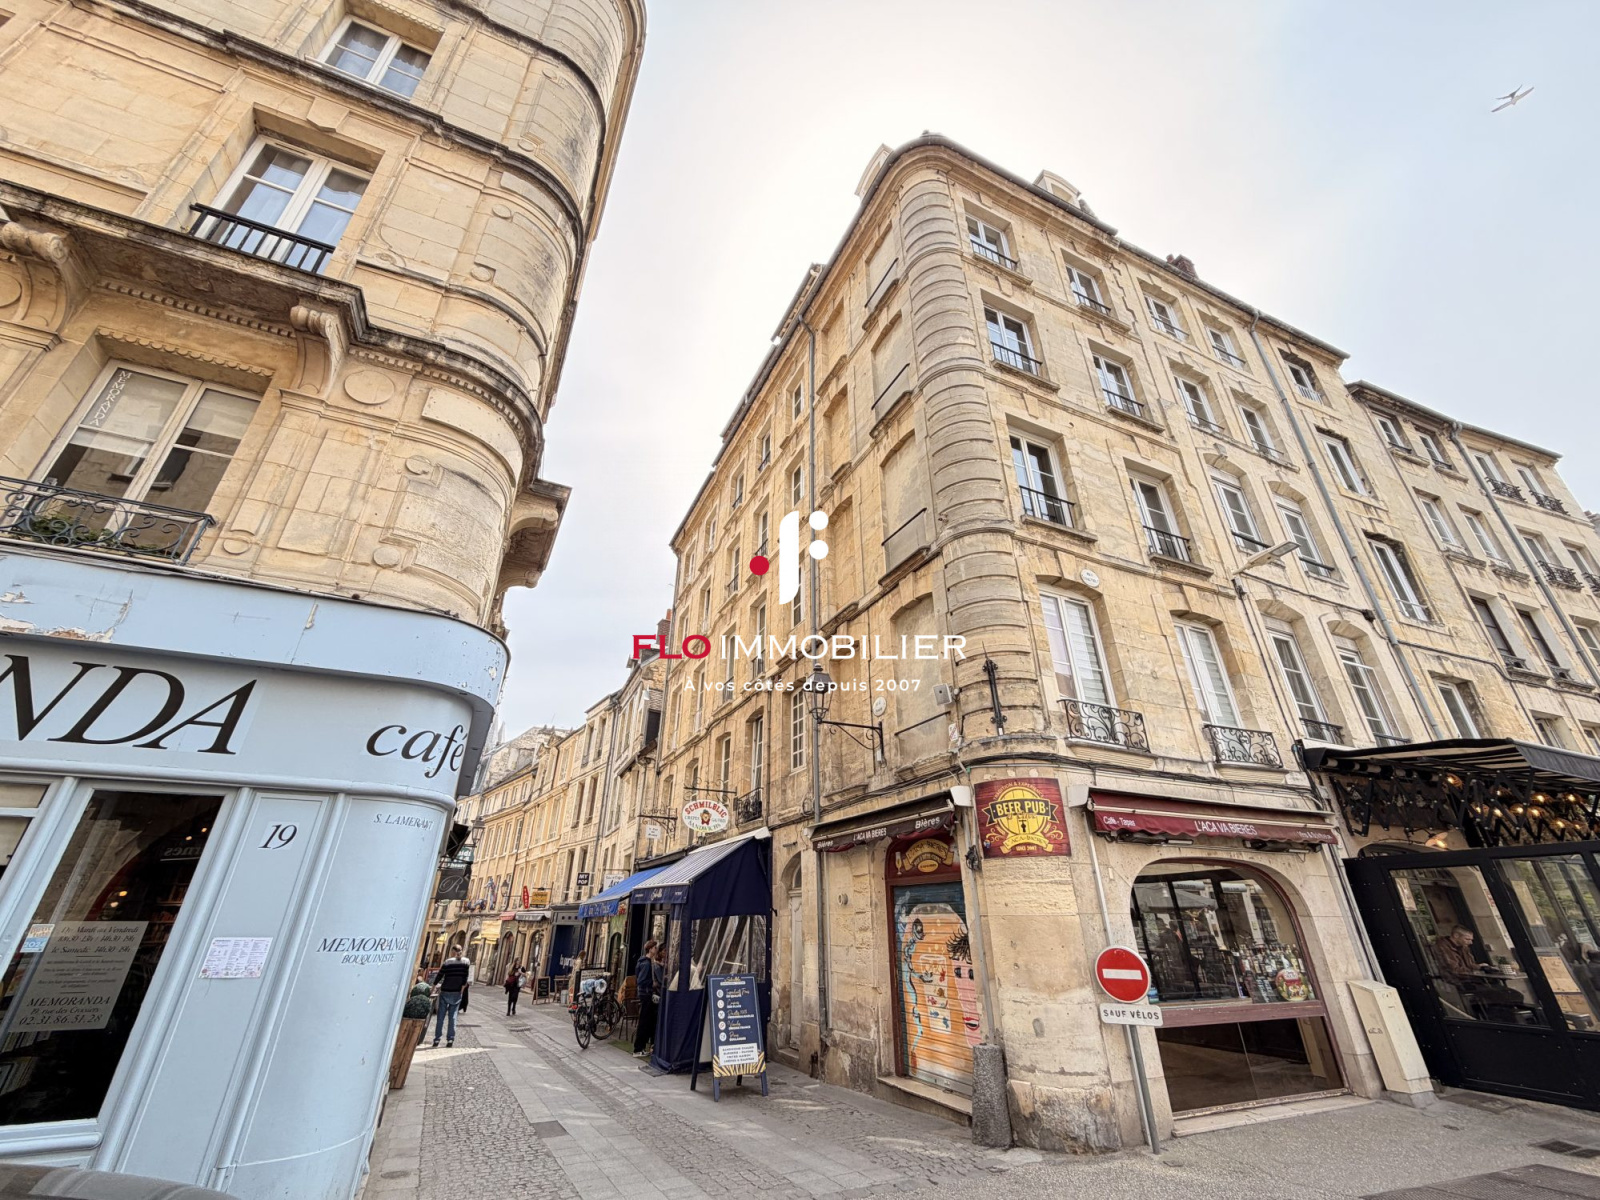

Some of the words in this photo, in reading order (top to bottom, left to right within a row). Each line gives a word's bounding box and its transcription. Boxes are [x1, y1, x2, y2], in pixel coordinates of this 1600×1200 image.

[90, 371, 132, 426] MEMORANDA
[366, 724, 467, 778] café
[685, 801, 728, 818] SCHMILBLIC
[996, 801, 1021, 816] BEER
[1024, 800, 1046, 814] PUB
[914, 816, 940, 829] Bières
[1228, 823, 1258, 836] BIERES
[258, 824, 297, 850] 19
[816, 840, 834, 849] Bières
[341, 953, 396, 966] BOUQUINISTE
[27, 996, 111, 1007] MEMORANDA
[1103, 1009, 1126, 1018] SAUF
[1130, 1009, 1160, 1020] VÉLOS
